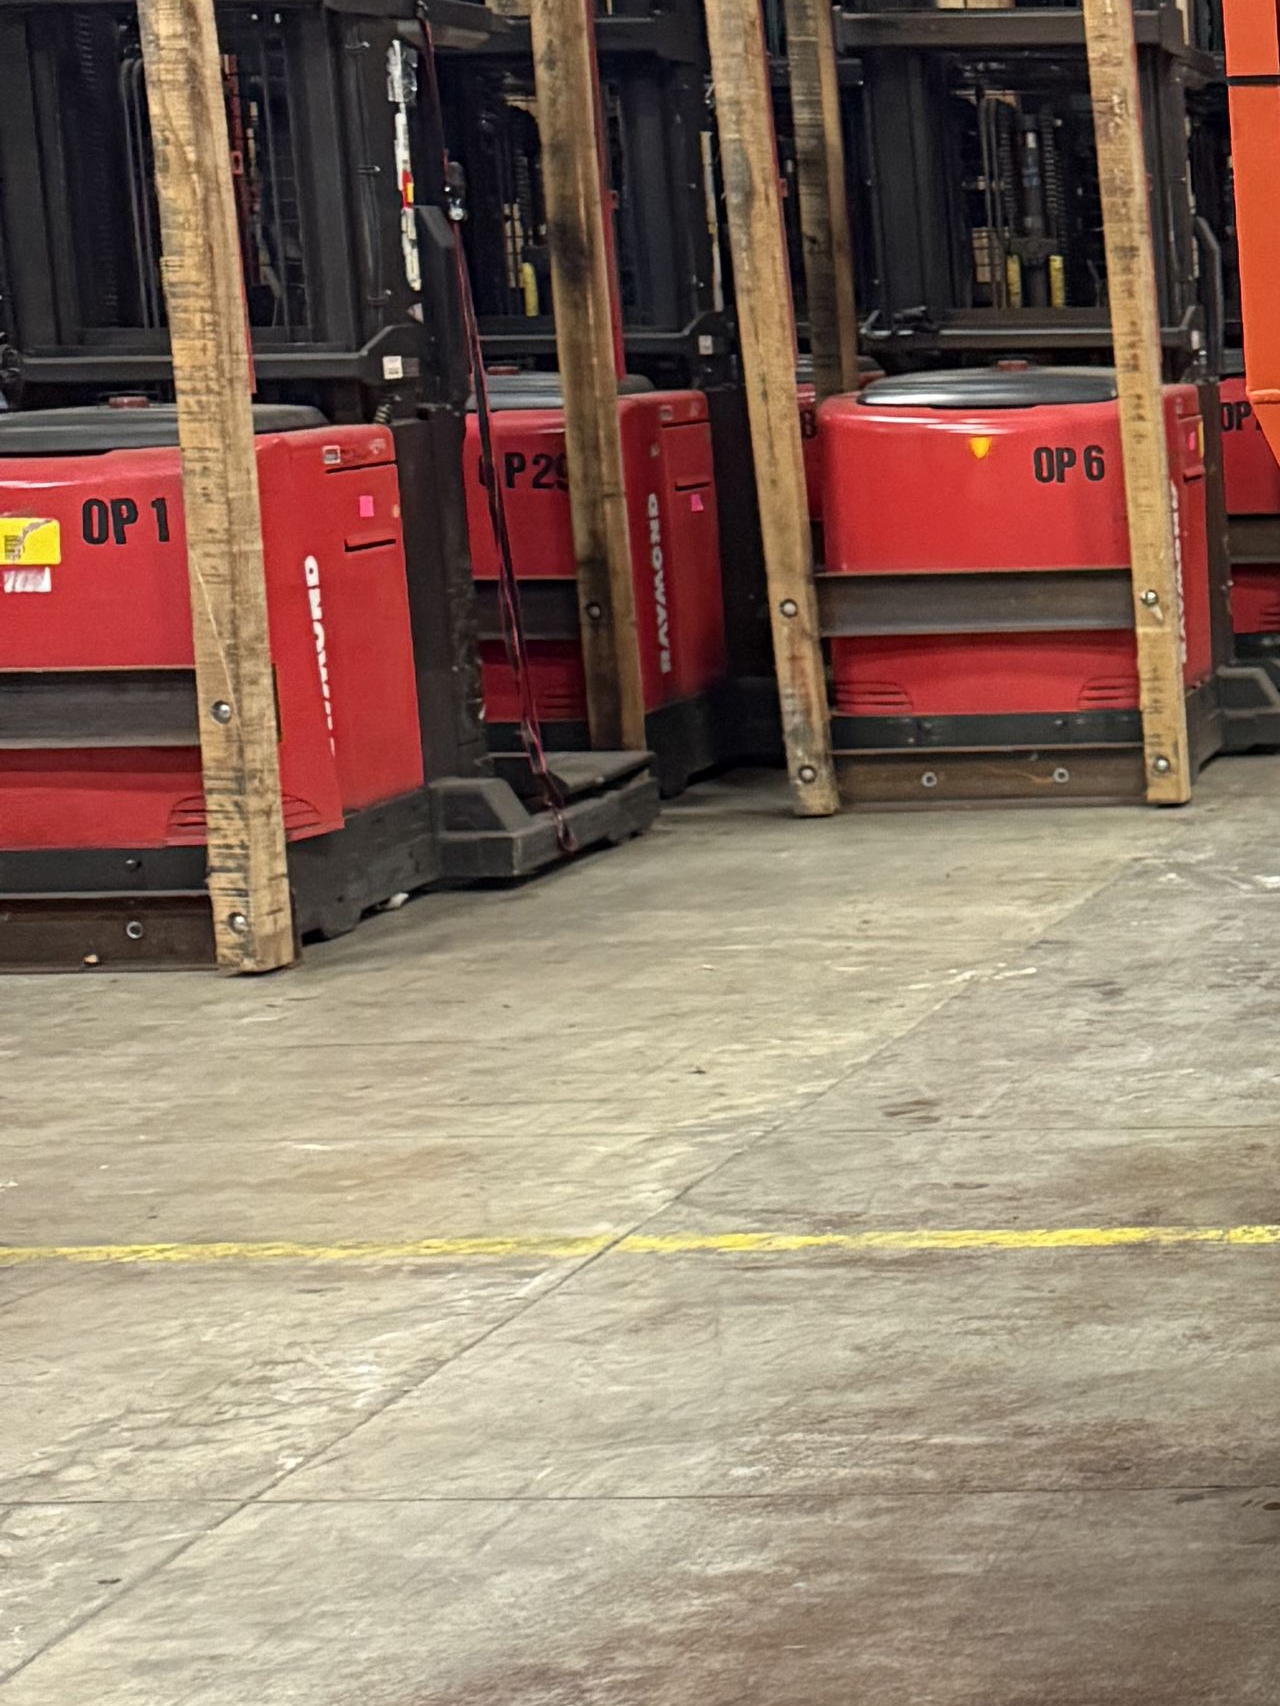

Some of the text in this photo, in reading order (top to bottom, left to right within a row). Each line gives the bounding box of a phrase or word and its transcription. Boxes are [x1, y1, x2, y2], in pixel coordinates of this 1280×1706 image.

[1033, 445, 1105, 483] OP 6
[81, 497, 170, 545] OP 1
[648, 492, 672, 674] RAYMOND
